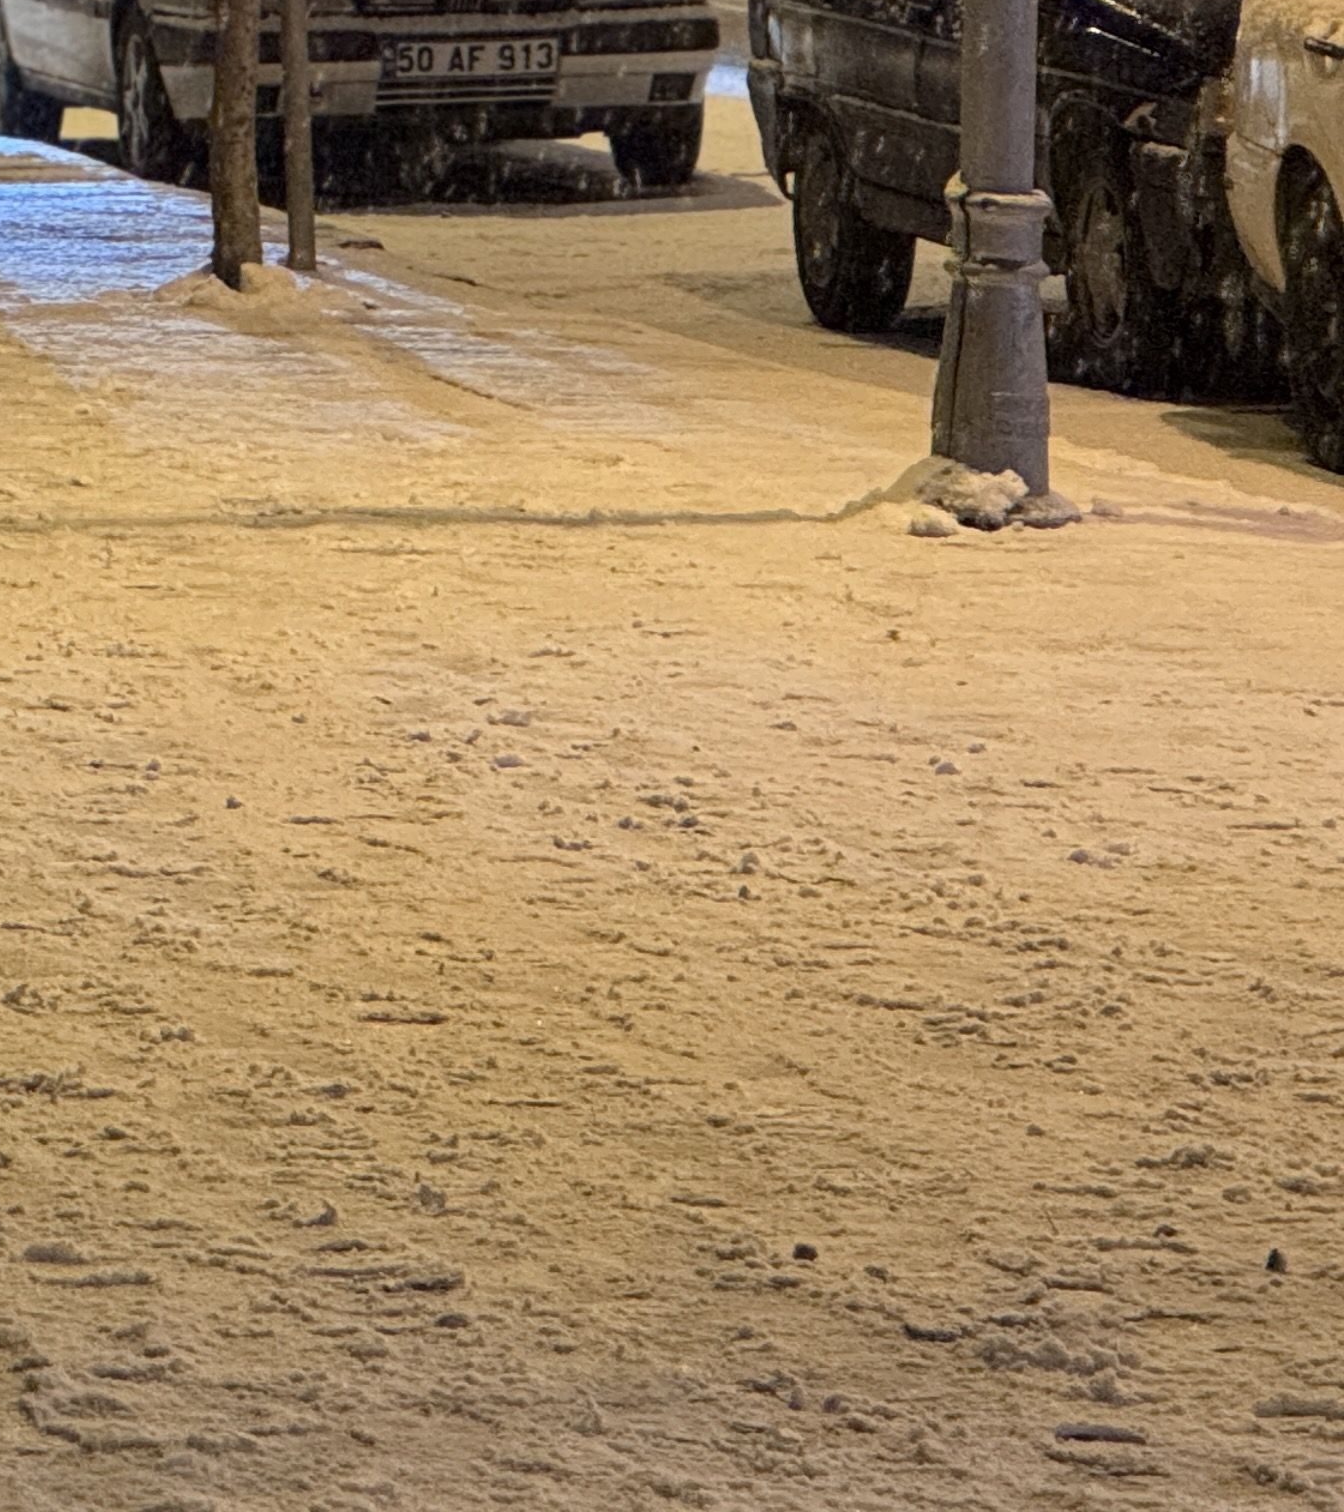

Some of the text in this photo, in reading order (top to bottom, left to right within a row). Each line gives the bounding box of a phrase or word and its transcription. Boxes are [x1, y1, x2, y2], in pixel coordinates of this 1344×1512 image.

[399, 42, 553, 72] 50 AF 913
